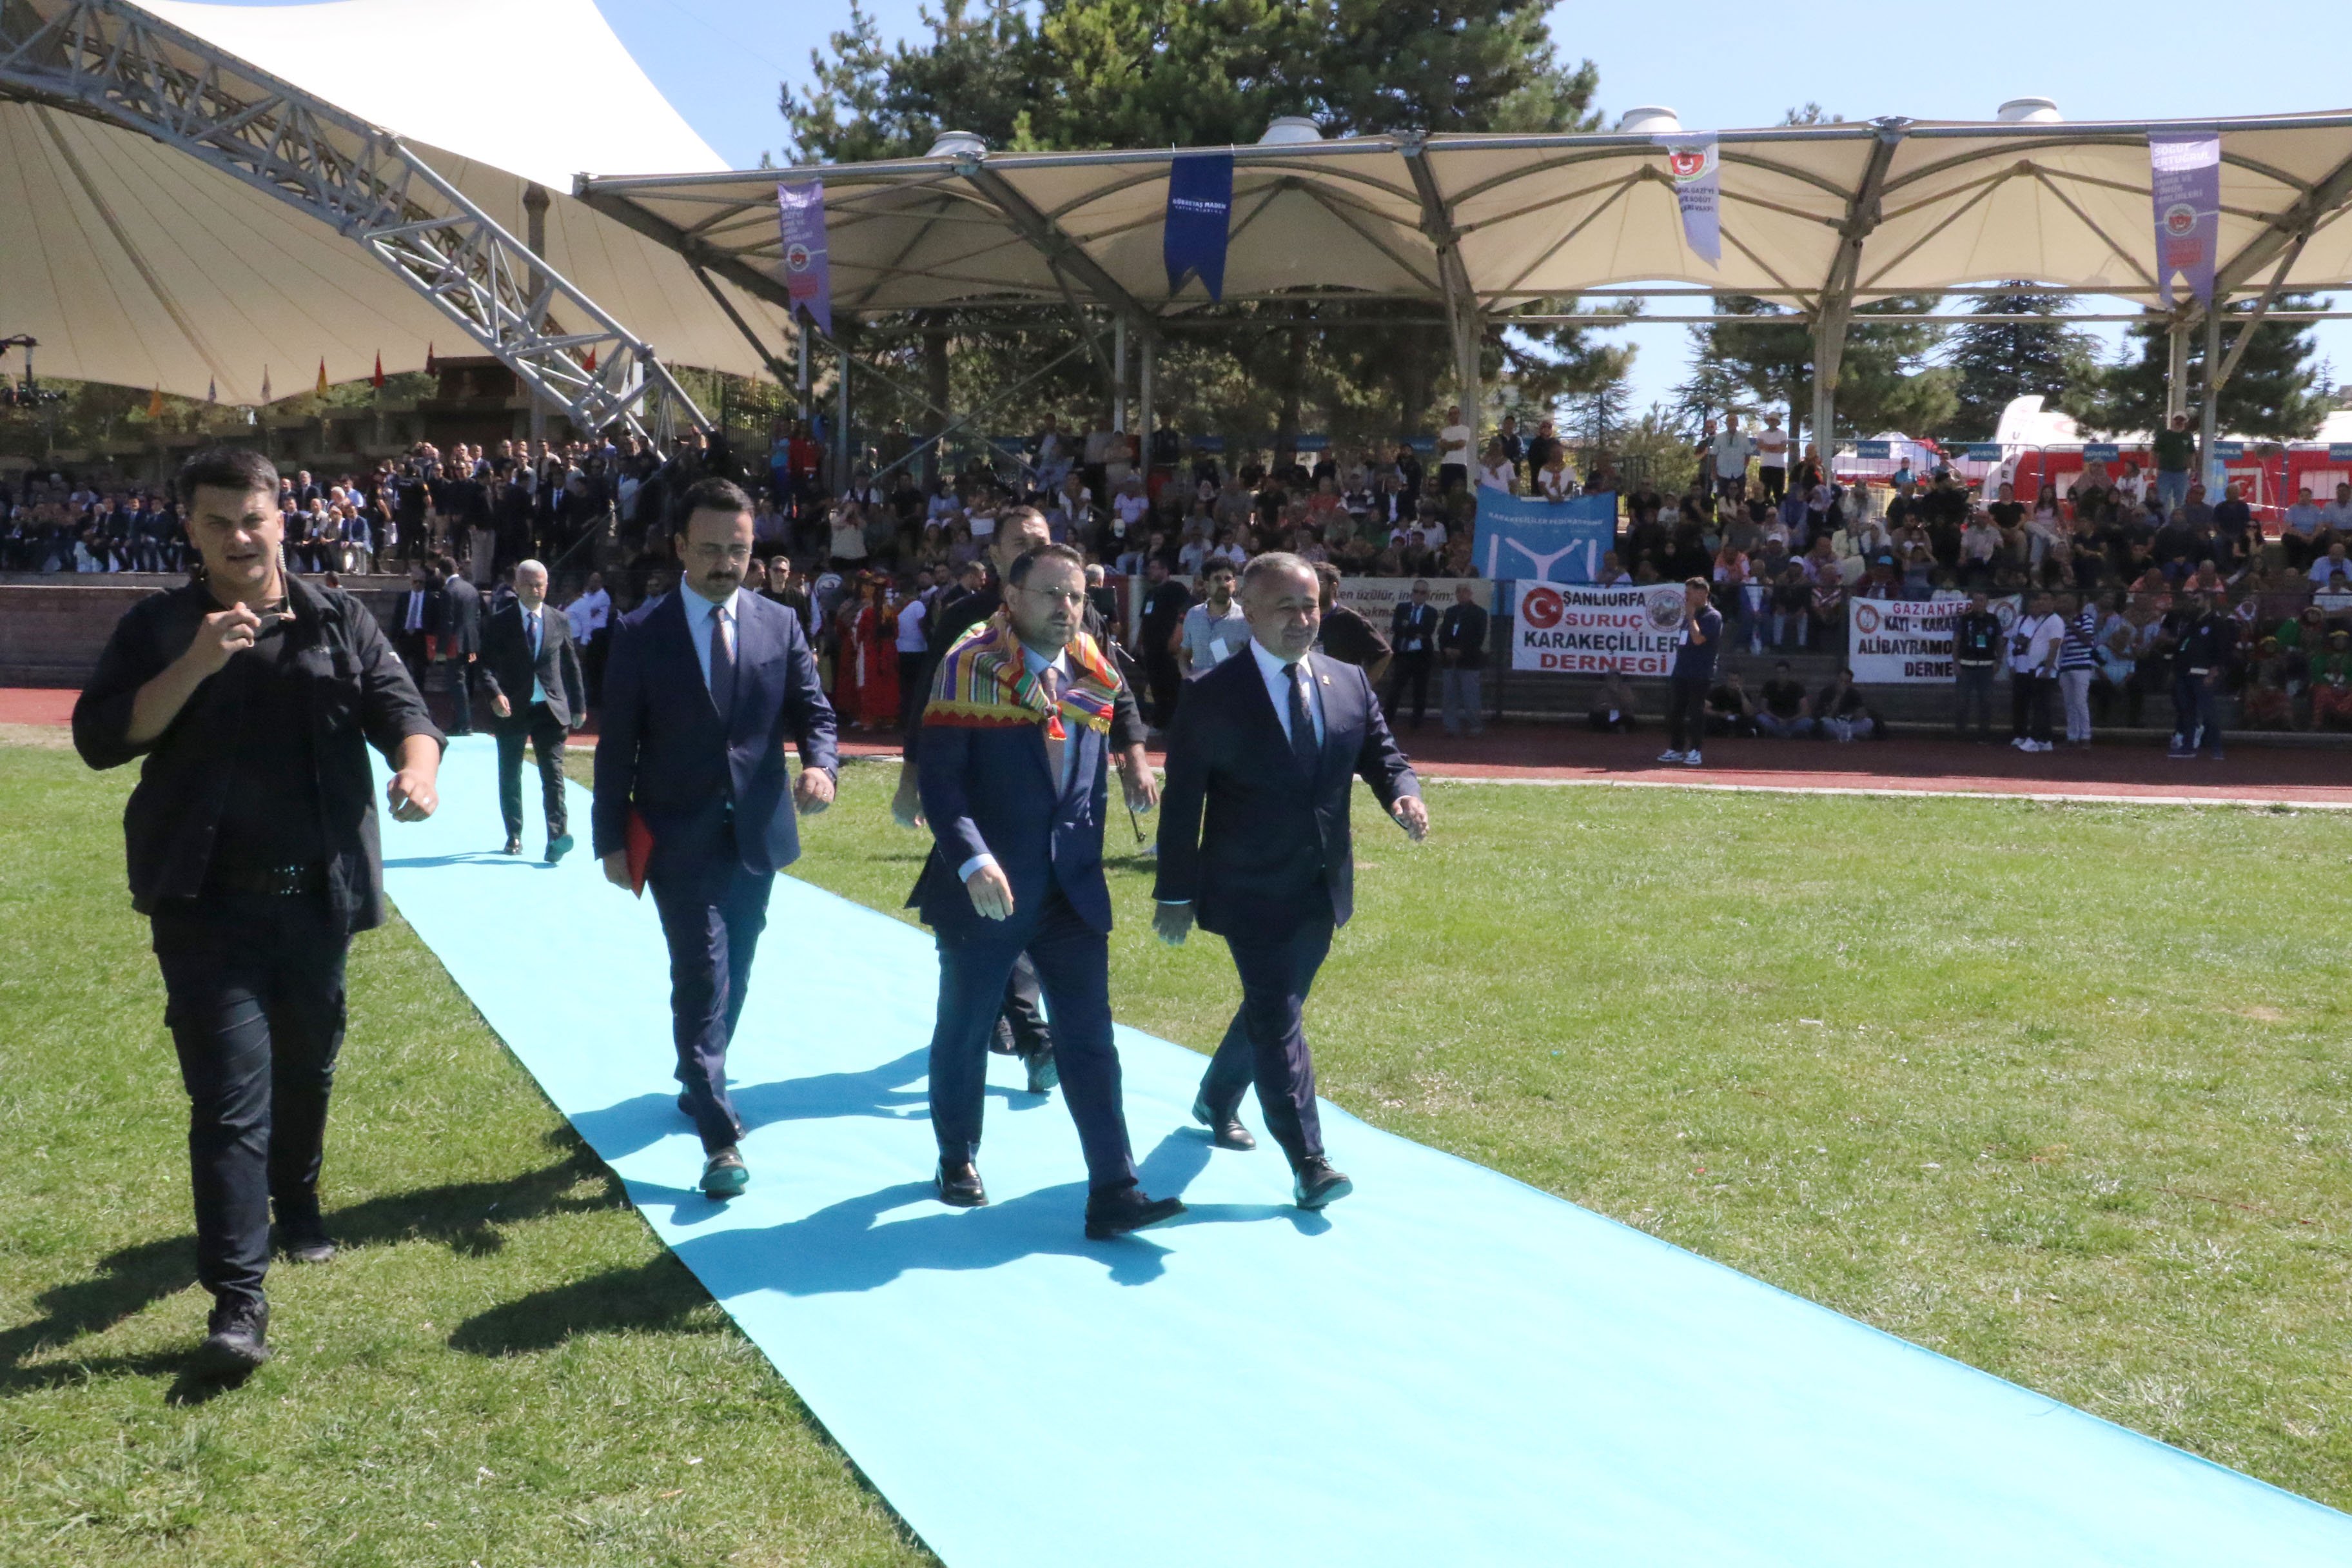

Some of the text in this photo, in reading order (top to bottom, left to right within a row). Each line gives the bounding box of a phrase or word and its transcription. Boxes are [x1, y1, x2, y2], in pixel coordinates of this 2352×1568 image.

[1563, 591, 1646, 607] ŞANLIURFA
[1565, 613, 1643, 631] SURUÇ
[1885, 615, 1909, 632] KAYI
[1858, 636, 1954, 654] ALİBAYRAMO
[1905, 662, 1954, 677] DERNE
